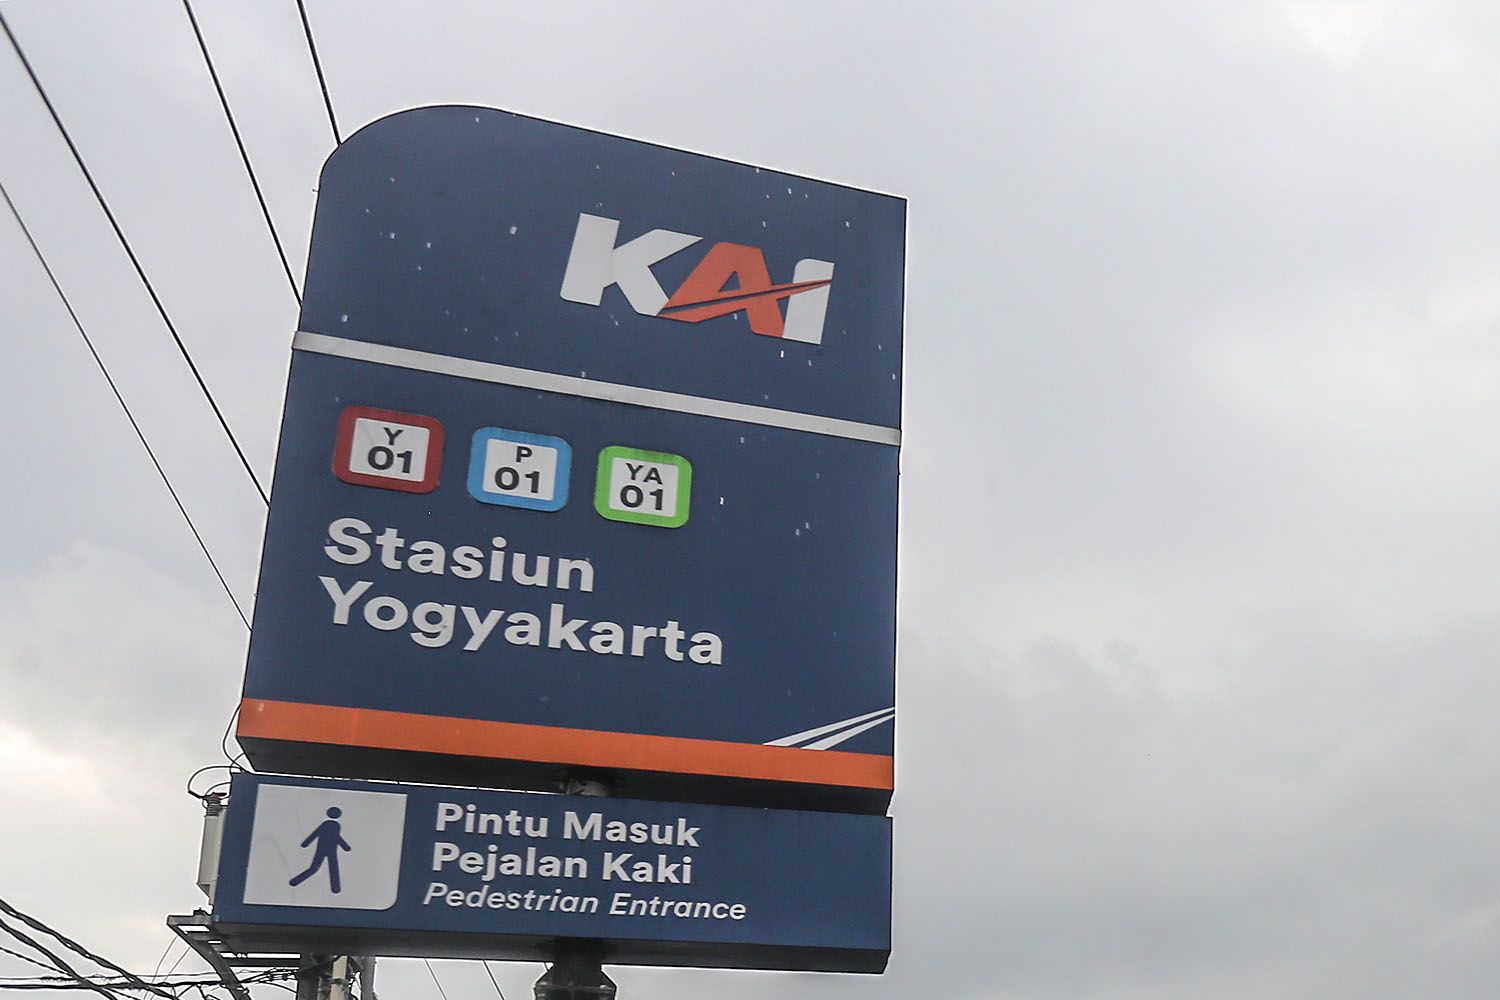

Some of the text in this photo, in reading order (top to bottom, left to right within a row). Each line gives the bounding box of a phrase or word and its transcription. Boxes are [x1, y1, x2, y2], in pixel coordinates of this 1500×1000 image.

[560, 212, 835, 345] KAI
[383, 426, 404, 446] Y
[367, 446, 412, 474] 01
[515, 446, 533, 463] P
[494, 466, 541, 494] 01
[625, 462, 663, 485] YA
[619, 485, 665, 511] 01
[324, 517, 595, 593] Stasiun
[318, 575, 723, 665] Yogyakarta
[435, 802, 700, 848] Pintu Masuk
[431, 842, 692, 884] Pejalan Kaki
[423, 882, 747, 920] Pedestrian Entrance
